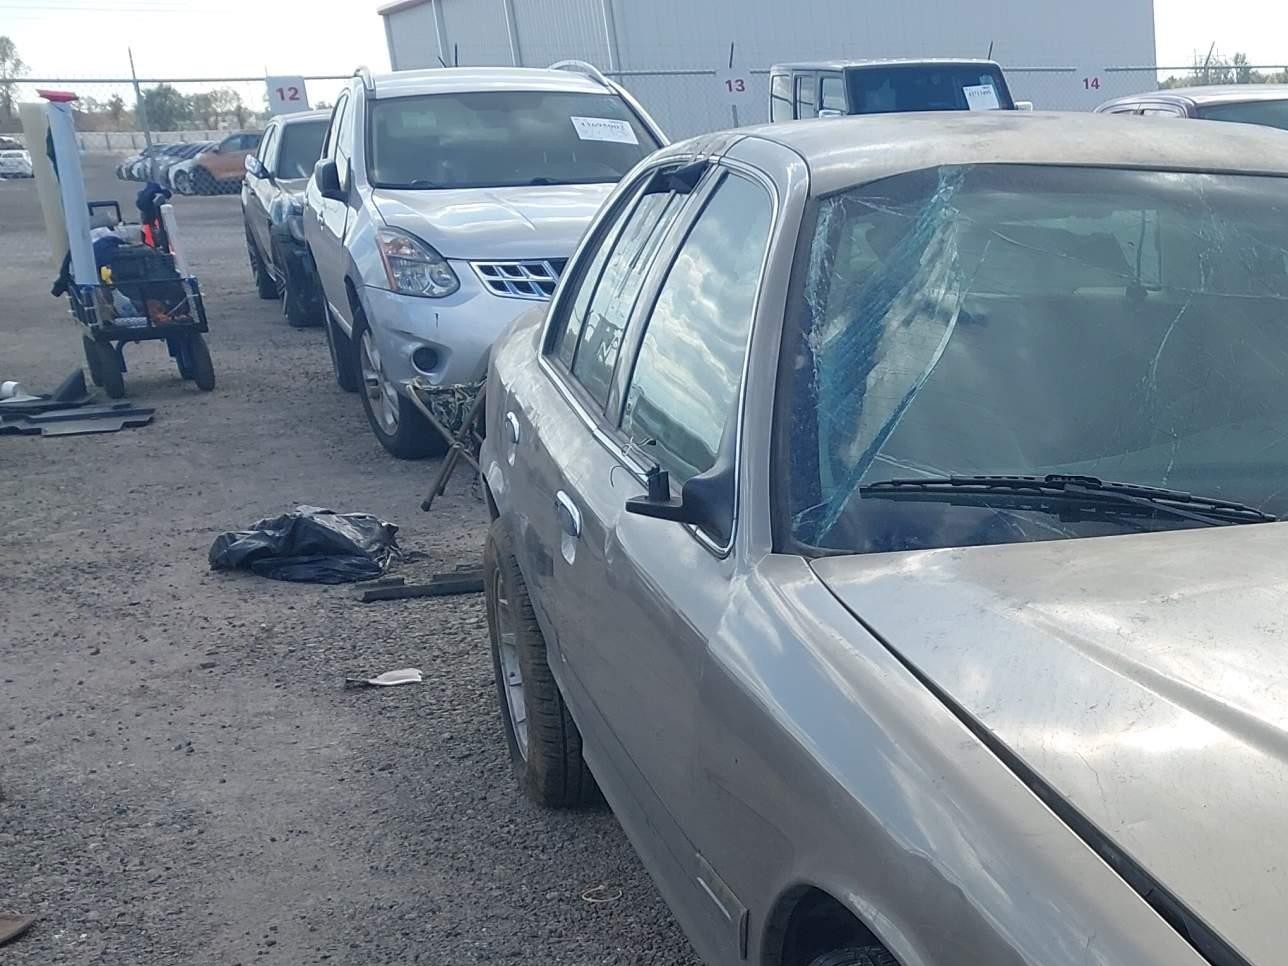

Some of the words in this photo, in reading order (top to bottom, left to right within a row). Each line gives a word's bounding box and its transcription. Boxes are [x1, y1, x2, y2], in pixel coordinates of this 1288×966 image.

[725, 79, 746, 93] 13
[1082, 77, 1100, 90] 14
[275, 87, 301, 102] 12
